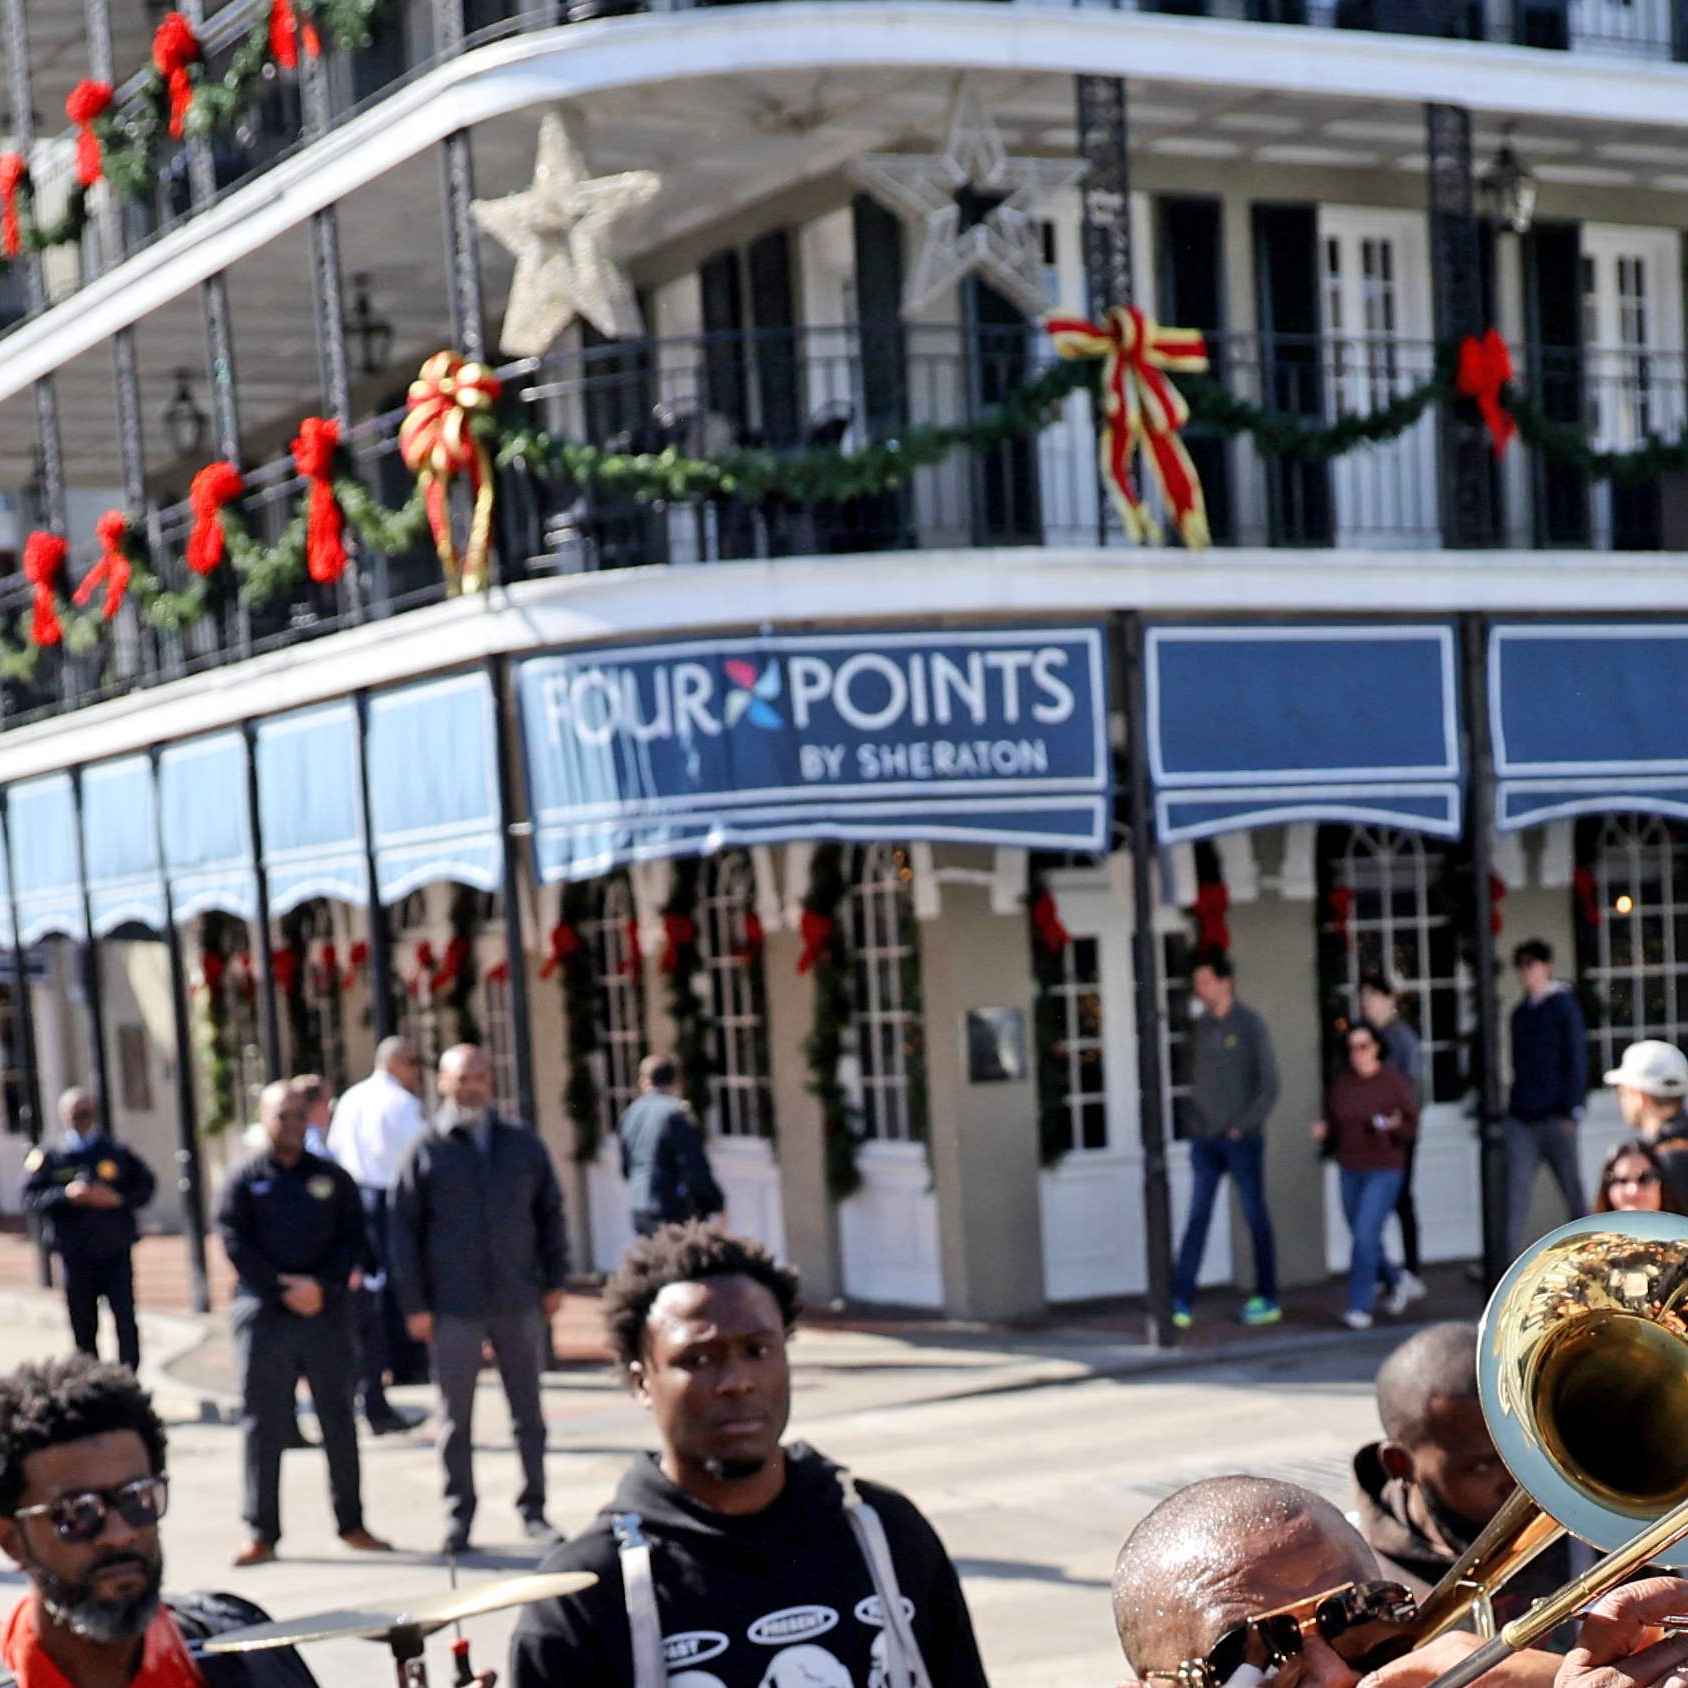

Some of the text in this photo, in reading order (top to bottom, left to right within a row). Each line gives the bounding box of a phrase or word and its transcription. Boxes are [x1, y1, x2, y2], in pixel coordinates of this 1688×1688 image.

[544, 648, 1076, 747] FOUR POINTS
[800, 738, 1049, 781] BY SHERATON
